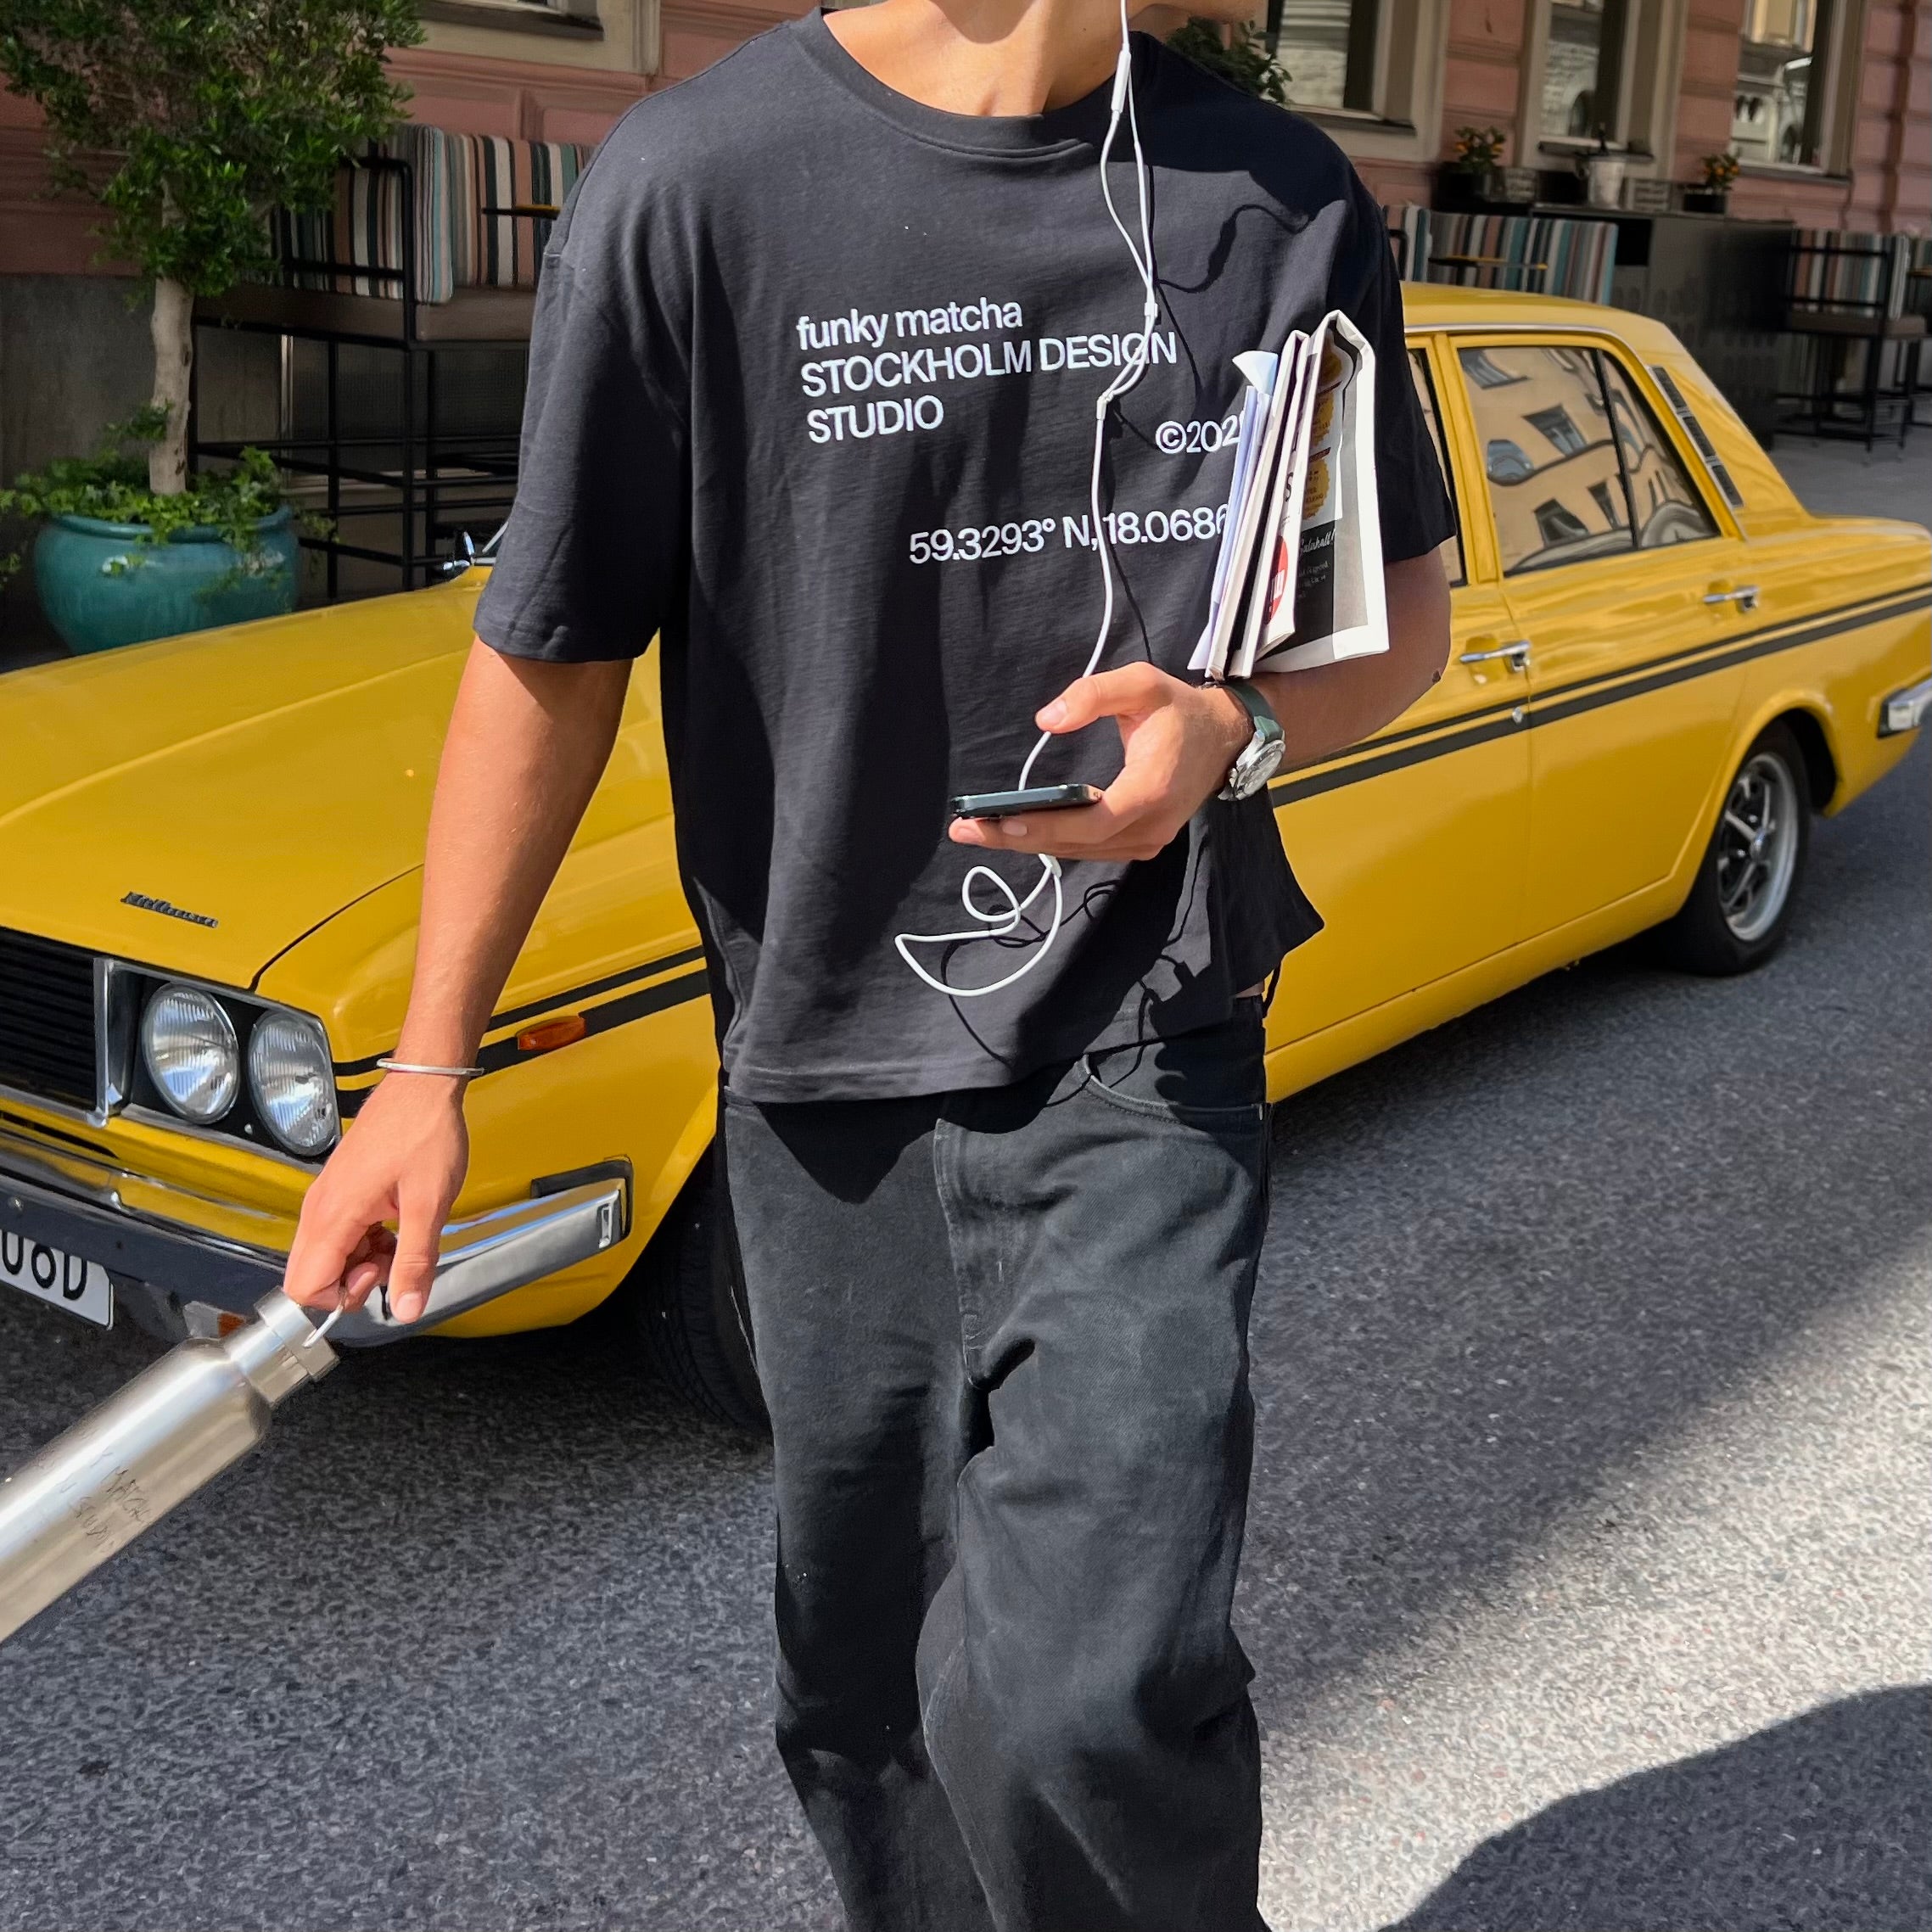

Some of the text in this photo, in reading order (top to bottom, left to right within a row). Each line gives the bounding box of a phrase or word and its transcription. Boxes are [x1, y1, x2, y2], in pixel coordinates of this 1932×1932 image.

[796, 296, 1023, 349] funky matcha
[800, 331, 1177, 398] STOCKHOLM DESIGN
[806, 395, 944, 444] STUDIO
[1155, 410, 1245, 454] ©202
[909, 518, 1056, 564] 59.3293°
[1062, 514, 1099, 552] N,
